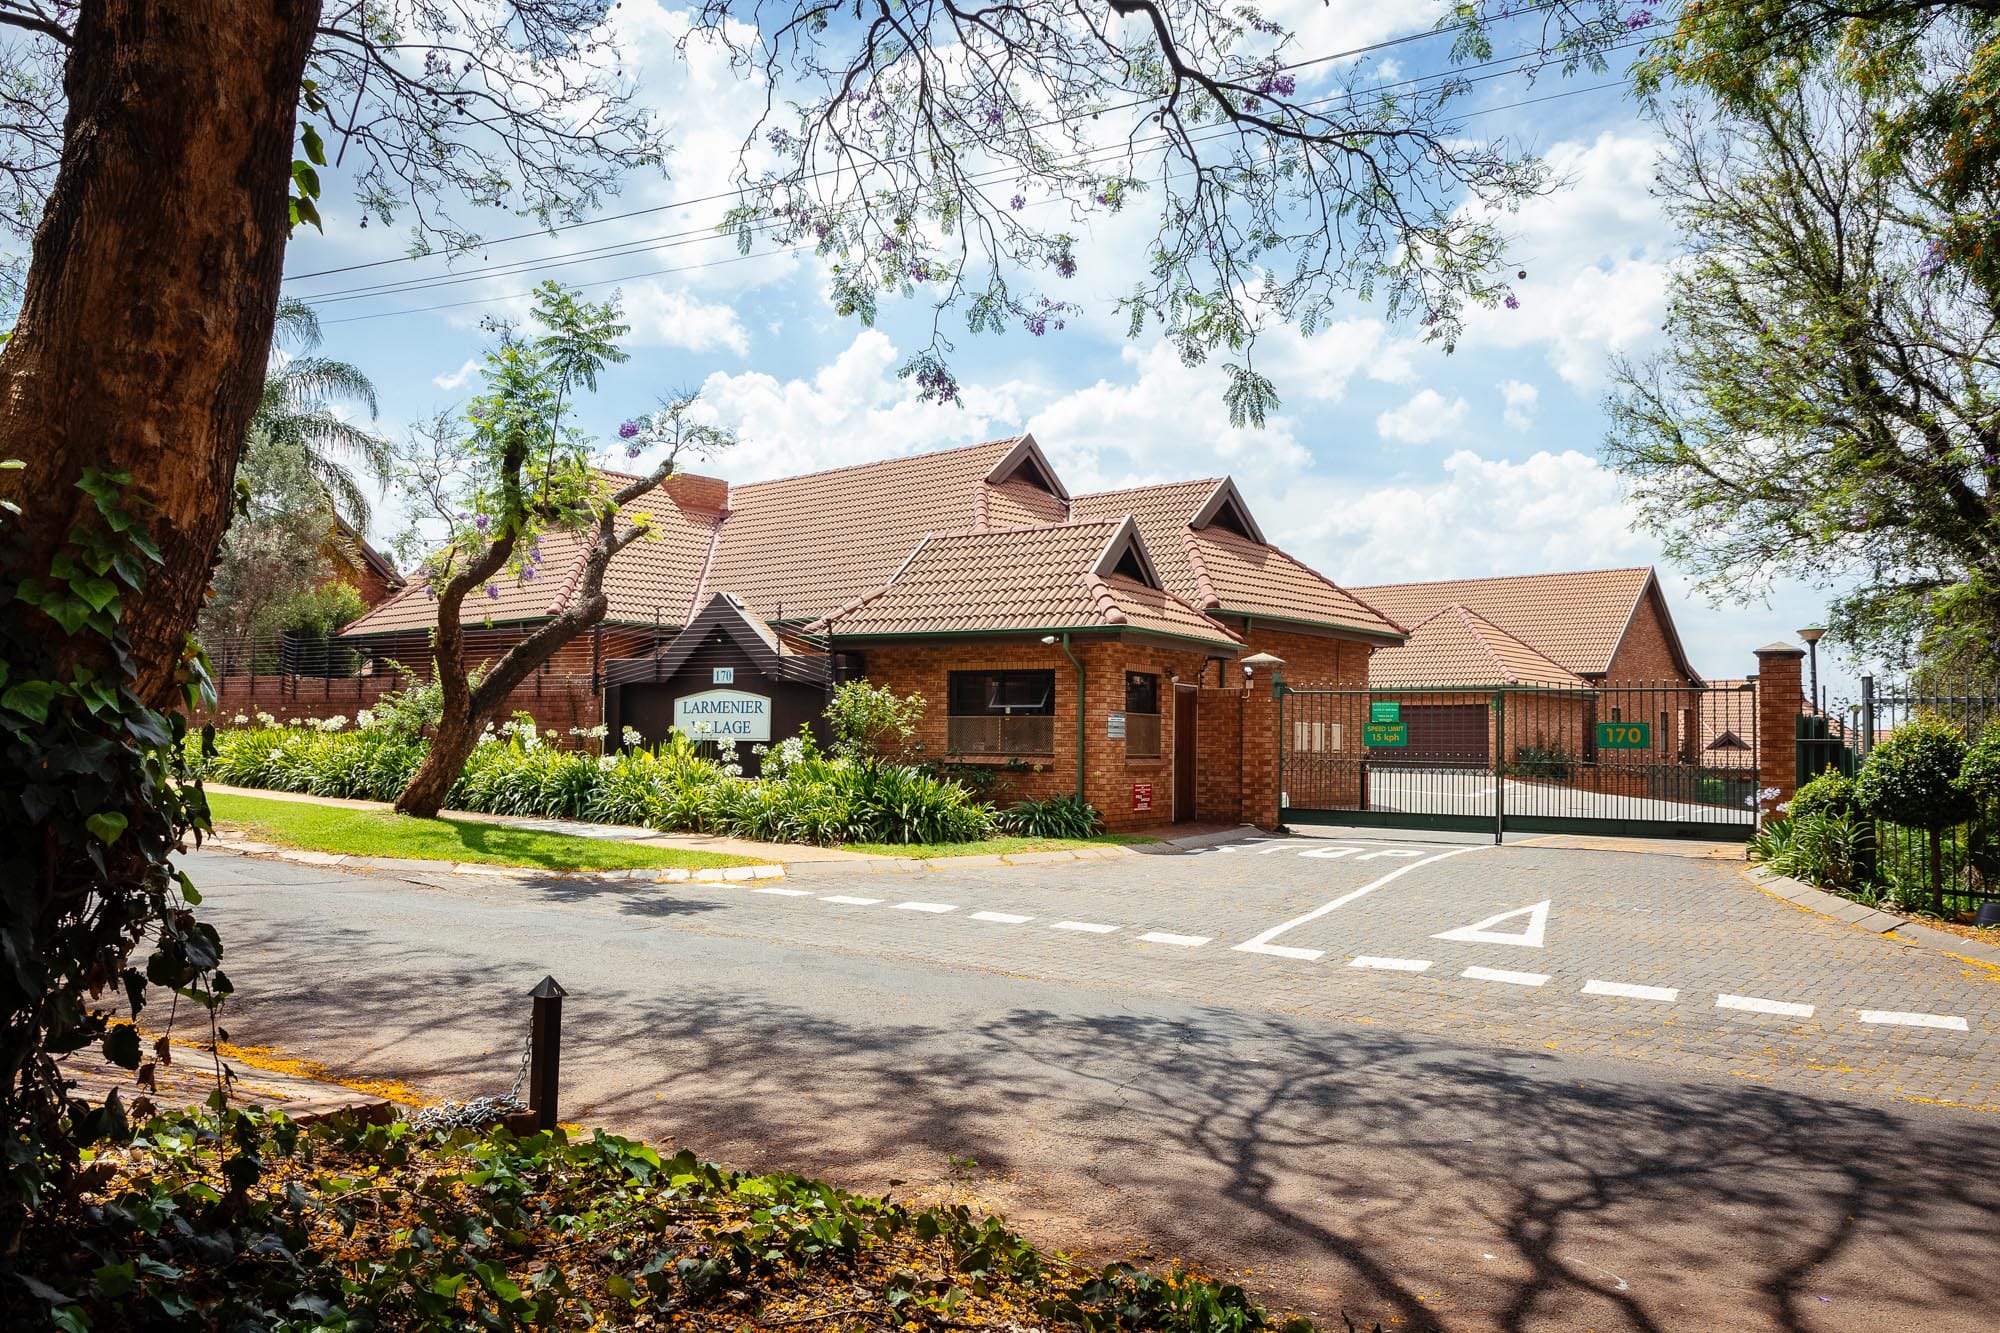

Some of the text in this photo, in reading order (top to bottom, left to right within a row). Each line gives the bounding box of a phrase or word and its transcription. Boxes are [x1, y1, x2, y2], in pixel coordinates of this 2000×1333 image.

[715, 670, 732, 681] 170
[683, 701, 764, 714] LARMENIER
[691, 720, 751, 734] LAGE
[1372, 733, 1399, 743] 15 kph
[1606, 727, 1642, 744] 170
